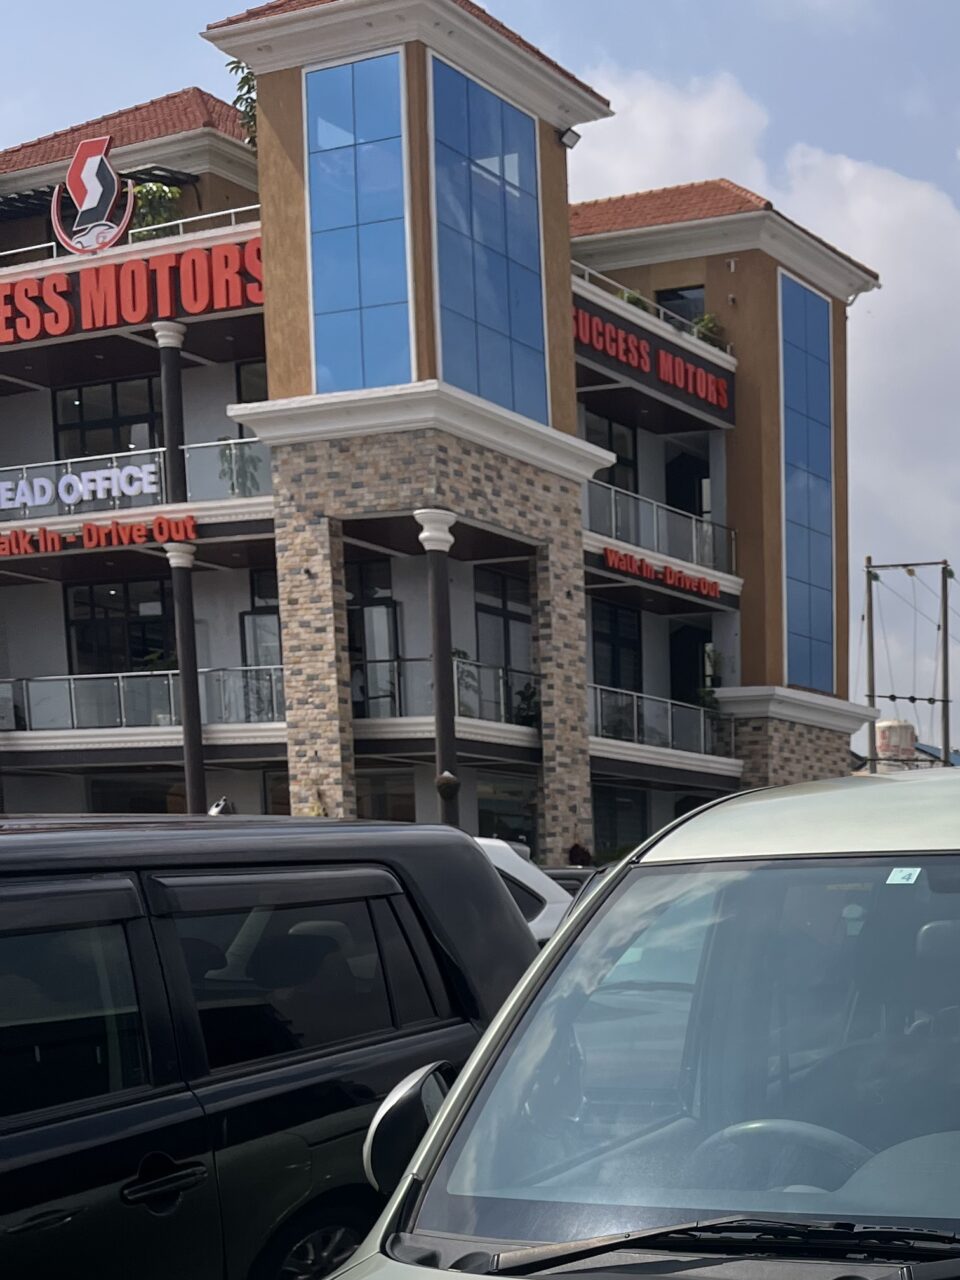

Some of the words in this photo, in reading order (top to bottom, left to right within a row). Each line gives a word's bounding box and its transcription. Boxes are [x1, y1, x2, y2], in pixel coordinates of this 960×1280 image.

[79, 237, 264, 330] MOTORS
[657, 349, 729, 409] MOTORS
[58, 464, 159, 505] OFFICE
[82, 520, 147, 549] Drive
[152, 515, 197, 543] Out
[604, 547, 640, 575] Walk
[664, 565, 699, 591] Drive
[699, 577, 720, 598] Out
